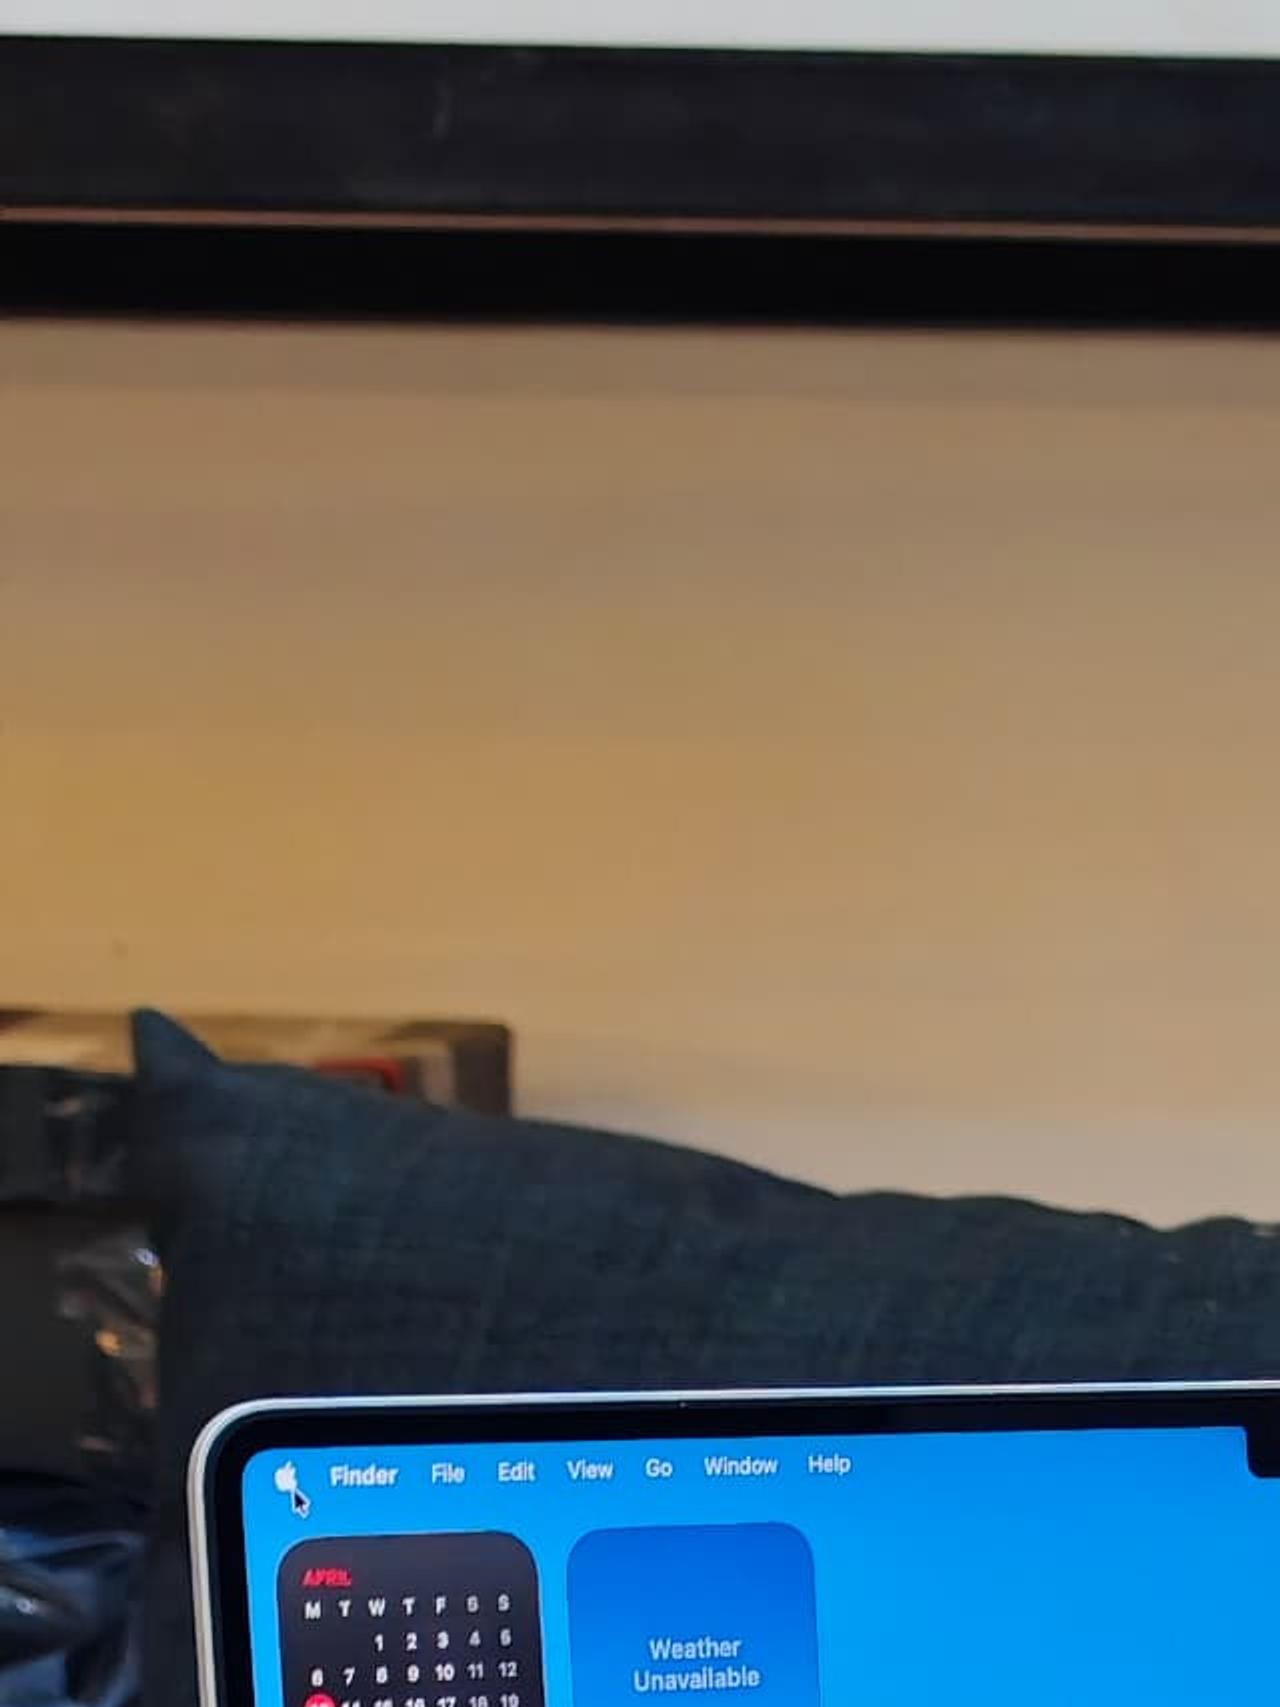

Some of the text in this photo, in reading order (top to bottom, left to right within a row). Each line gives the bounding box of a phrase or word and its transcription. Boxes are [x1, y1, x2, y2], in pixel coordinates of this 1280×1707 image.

[329, 1453, 851, 1487] Finder File Edit View Go Window Help
[303, 1568, 353, 1587] APRIL
[304, 1593, 510, 1620] M T W T F S S
[373, 1628, 512, 1652] 1 2 3 4 5
[649, 1635, 743, 1661] Weather
[310, 1660, 518, 1687] 6 7 8 9 10 11 12
[633, 1664, 761, 1692] Unavailable
